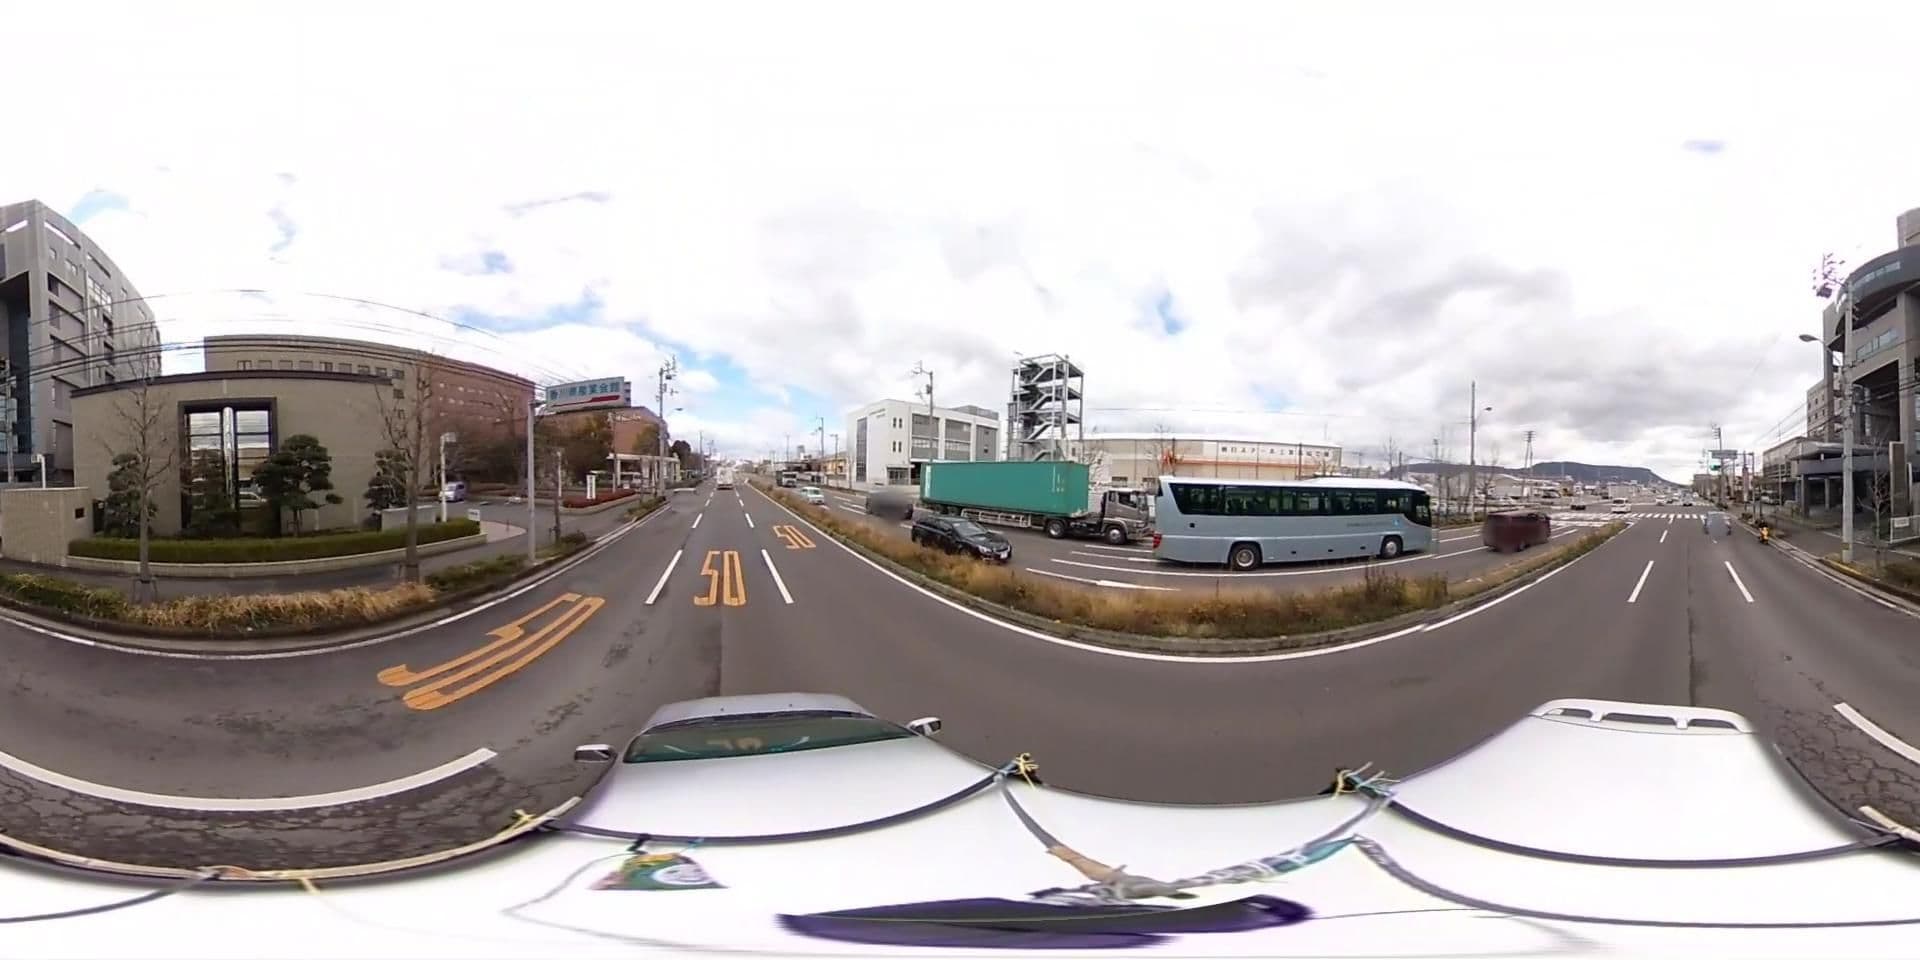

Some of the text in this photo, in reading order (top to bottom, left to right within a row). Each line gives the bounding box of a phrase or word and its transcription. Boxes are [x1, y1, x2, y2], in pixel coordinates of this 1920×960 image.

[772, 525, 817, 549] 50
[693, 550, 747, 606] 50
[377, 593, 606, 710] 50
